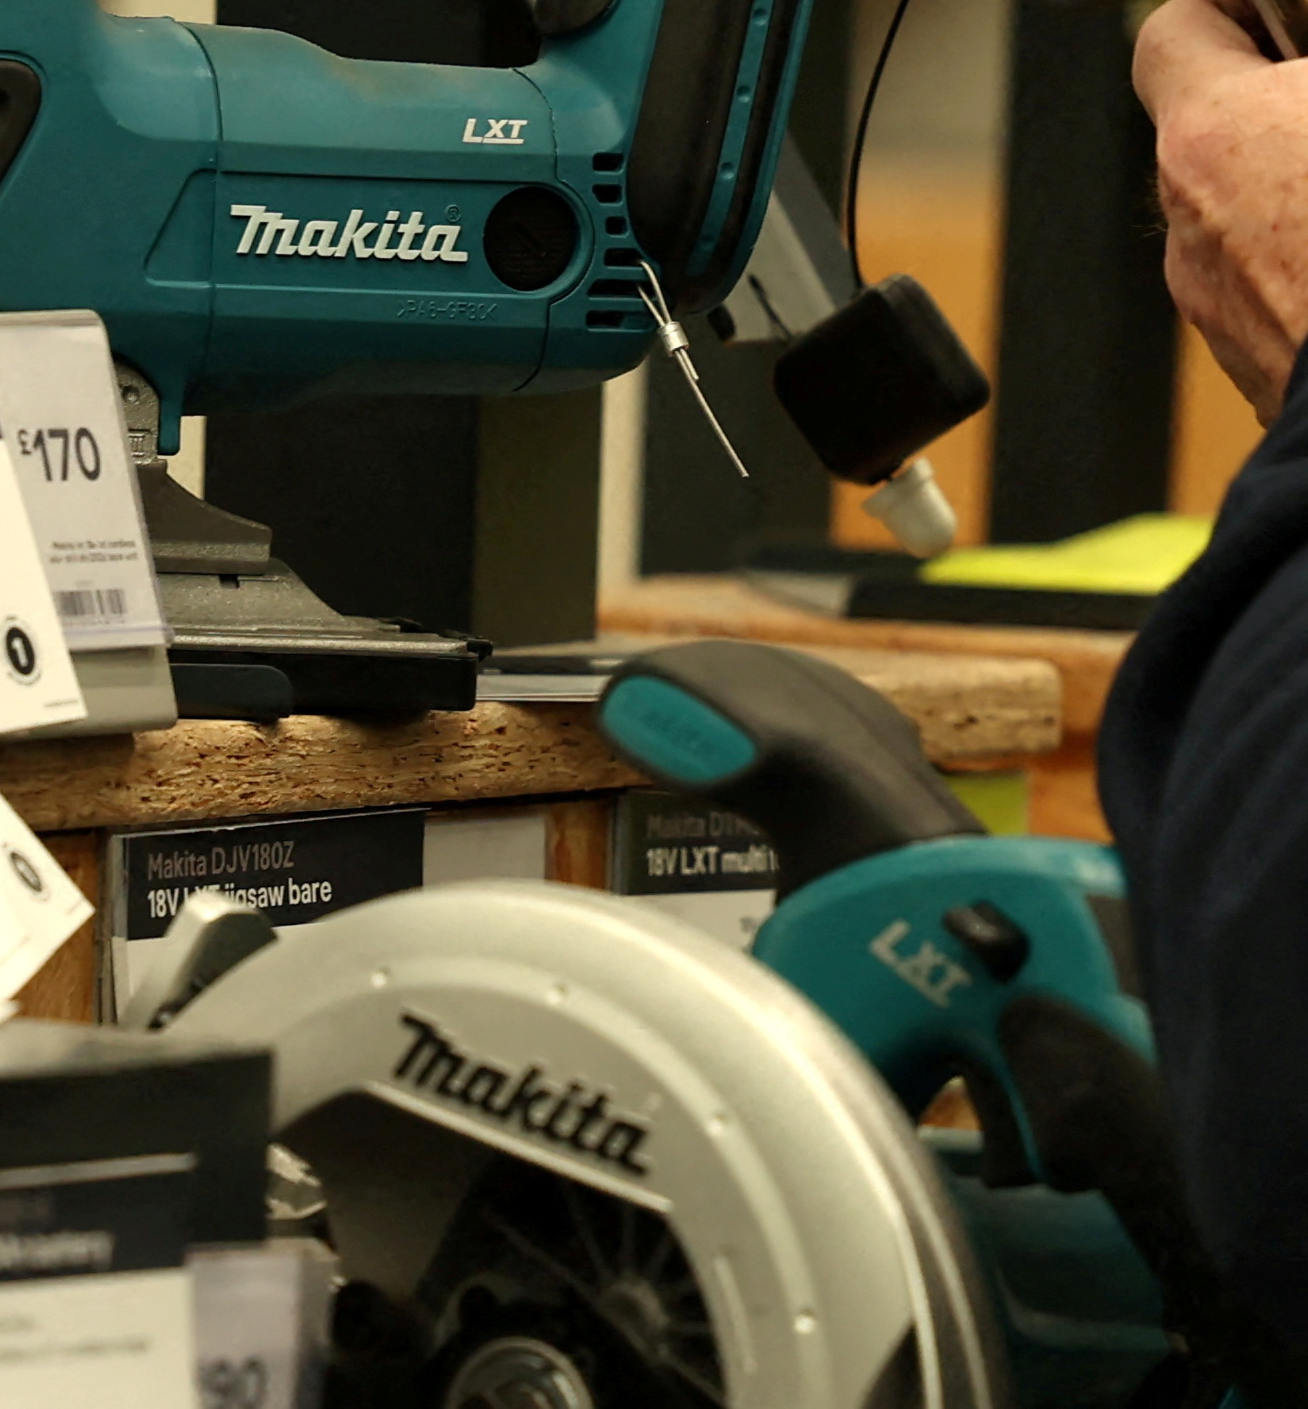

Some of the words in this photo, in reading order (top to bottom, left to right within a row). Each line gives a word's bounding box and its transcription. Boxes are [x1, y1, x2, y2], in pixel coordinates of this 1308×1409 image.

[462, 118, 528, 145] LXT
[230, 205, 469, 263] Makita
[17, 428, 101, 481] £170
[148, 849, 206, 881] Makita
[211, 841, 295, 875] DJV180Z
[680, 845, 719, 875] LXT
[147, 887, 179, 918] 18V
[288, 877, 332, 905] bare
[869, 918, 973, 1009] LXT
[394, 1011, 649, 1176] Makita
